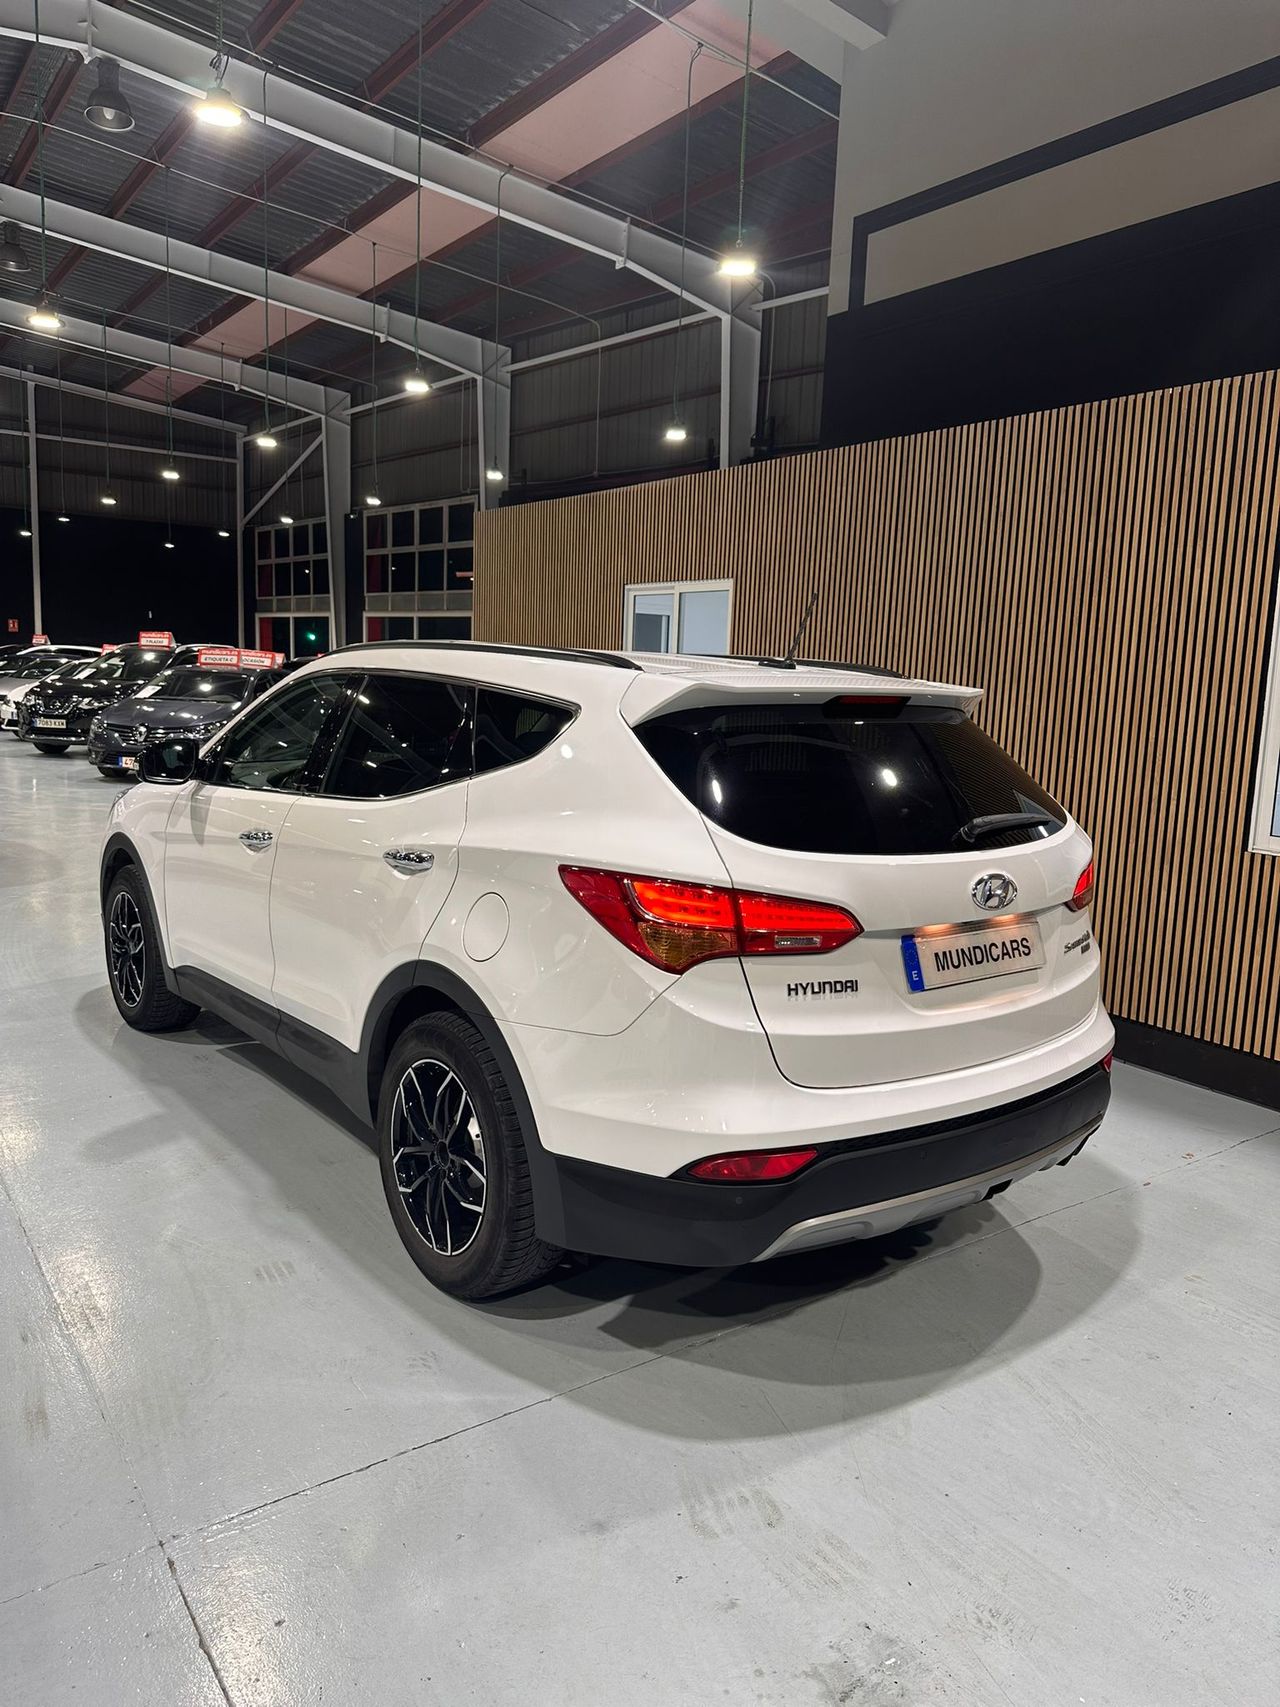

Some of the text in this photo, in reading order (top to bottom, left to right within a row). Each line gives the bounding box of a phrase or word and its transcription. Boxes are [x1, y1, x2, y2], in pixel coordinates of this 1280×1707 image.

[934, 937, 1032, 972] MUNDICARS
[911, 970, 919, 981] E
[787, 979, 859, 997] HYUNDAI
